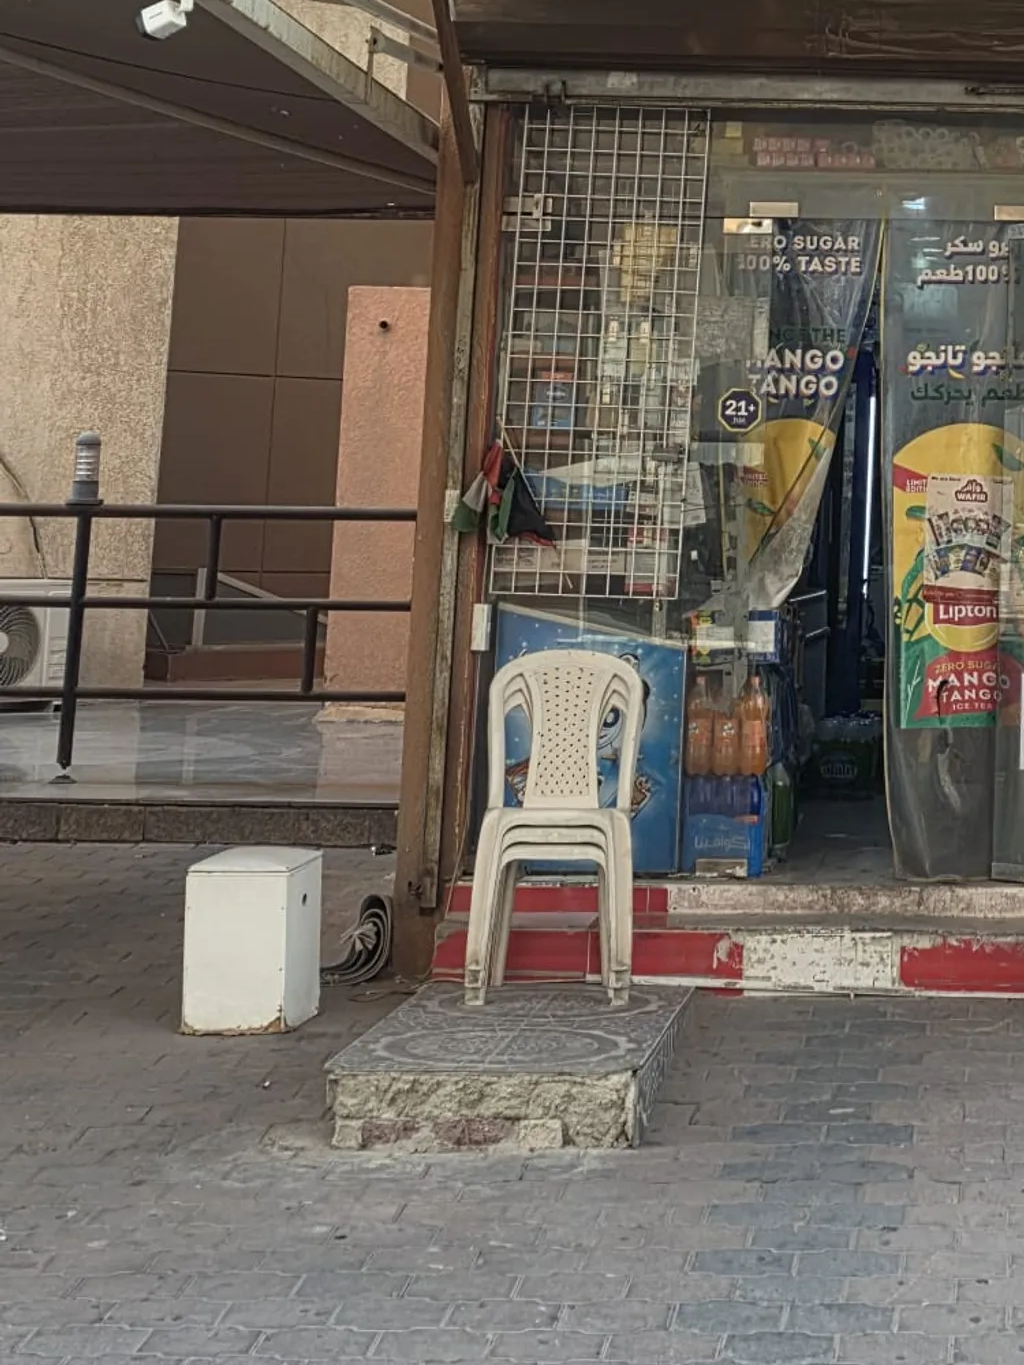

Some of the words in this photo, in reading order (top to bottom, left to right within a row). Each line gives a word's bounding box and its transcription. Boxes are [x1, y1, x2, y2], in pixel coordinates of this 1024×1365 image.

[792, 235, 861, 251] SUGAR
[944, 235, 984, 257] سكر
[737, 254, 791, 272] 100%
[798, 255, 863, 273] TASTE
[724, 399, 756, 417] 21+
[939, 604, 998, 622] Lipton
[935, 661, 964, 674] ZERO
[941, 689, 1002, 703] TANGO
